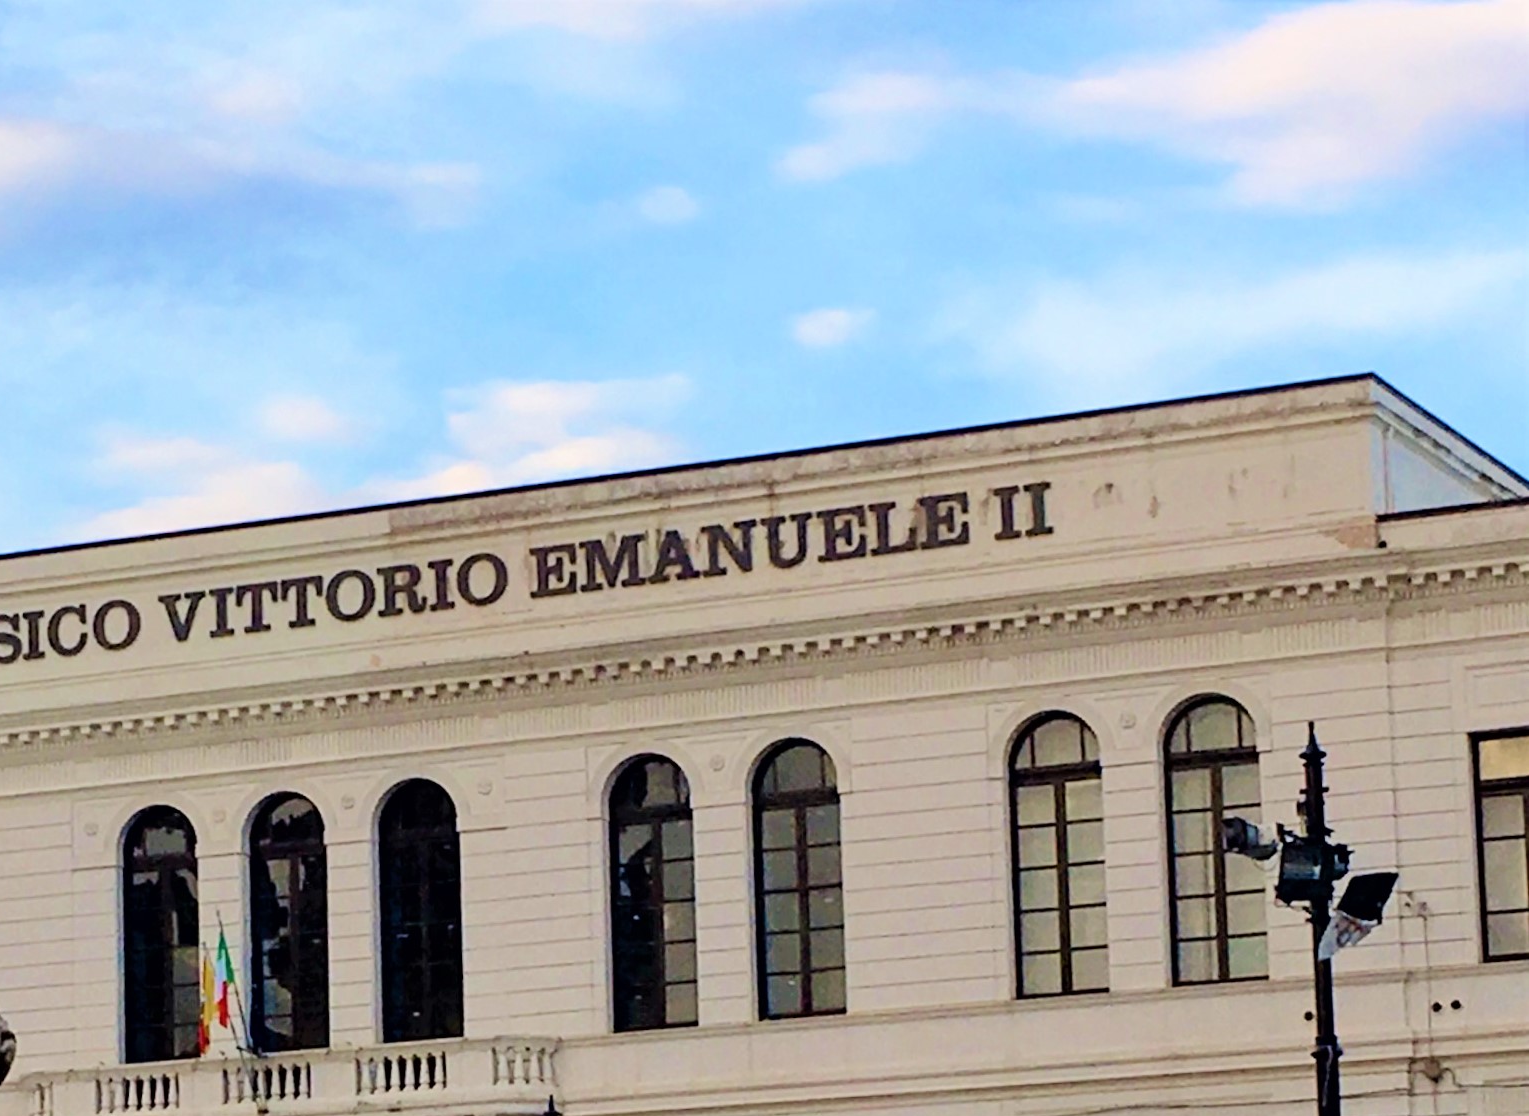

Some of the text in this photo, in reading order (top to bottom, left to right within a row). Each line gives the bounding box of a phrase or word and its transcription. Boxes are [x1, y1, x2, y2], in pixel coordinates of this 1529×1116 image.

[157, 553, 509, 643] VITTORIO
[528, 492, 970, 600] EMANUELE
[988, 481, 1055, 542] II
